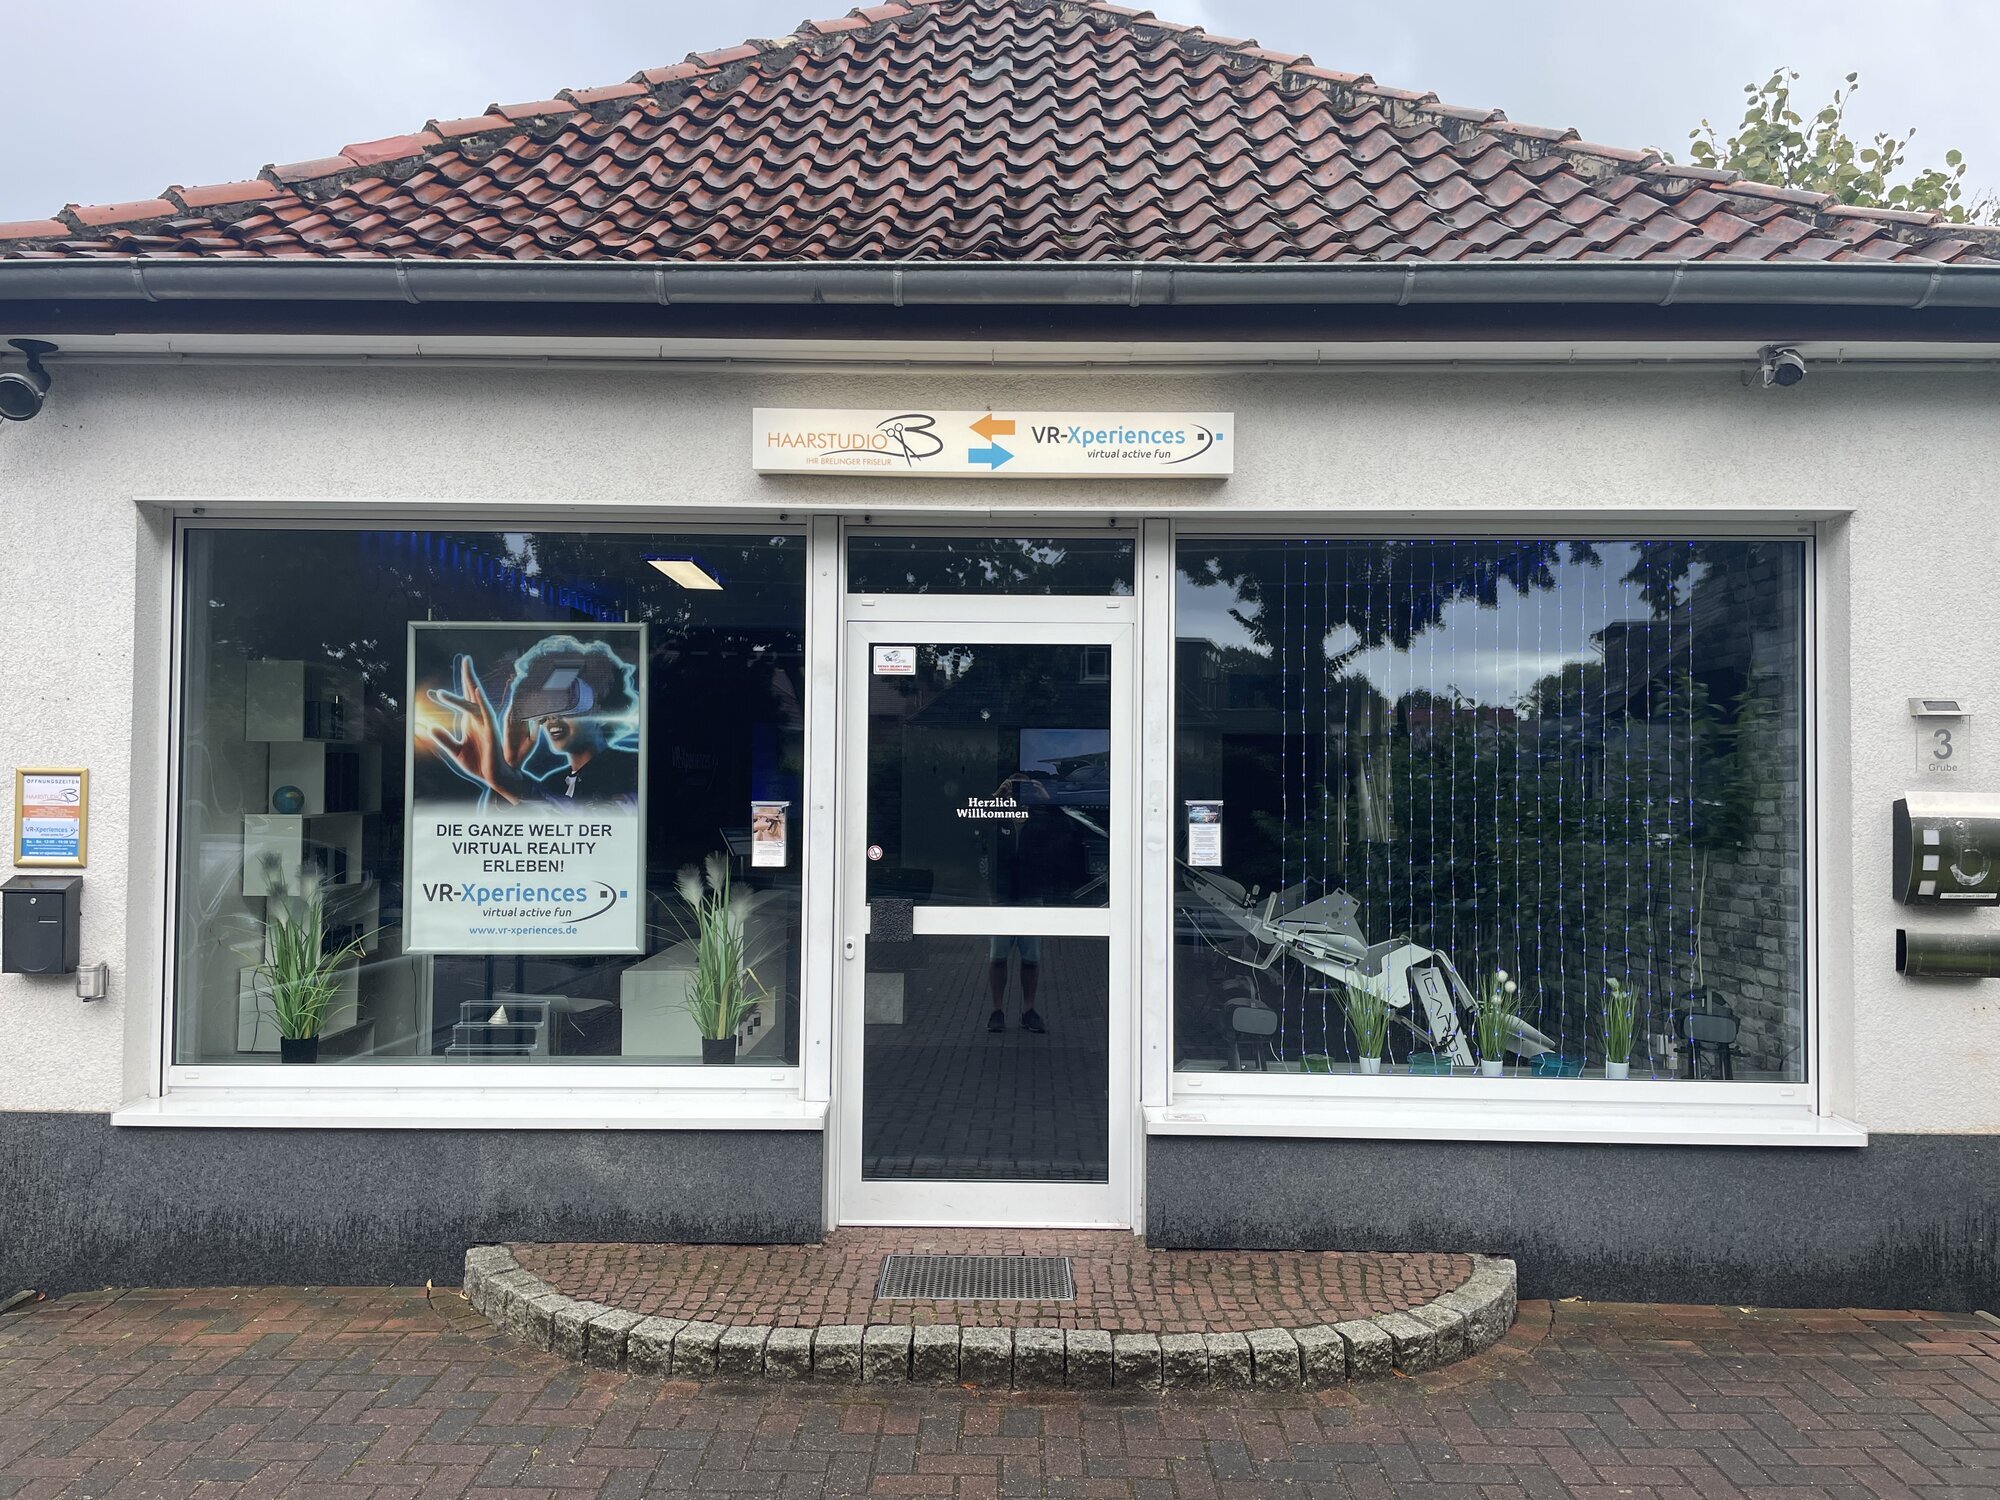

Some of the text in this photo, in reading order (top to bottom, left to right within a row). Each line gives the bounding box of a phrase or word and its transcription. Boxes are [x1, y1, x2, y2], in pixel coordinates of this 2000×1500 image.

[767, 432, 888, 450] HAARSTUDIO
[1031, 425, 1185, 448] VR-Xperiences
[1087, 449, 1171, 460] virtual active fun
[820, 458, 861, 466] BRELINGER
[862, 458, 892, 466] FRISEUR
[1933, 728, 1953, 760] 3
[1928, 763, 1958, 772] Grube
[968, 797, 1017, 807] Herzlich
[956, 808, 1029, 819] Willkommen
[436, 824, 613, 837] DIE GANZE WELT DER
[452, 842, 596, 855] VIRTUAL REALITY
[483, 860, 564, 872] ERLEBEN!
[422, 882, 588, 906] VR-Xperiences
[482, 907, 572, 918] virtual active fun
[469, 925, 578, 936] www.vr-xperiences.de
